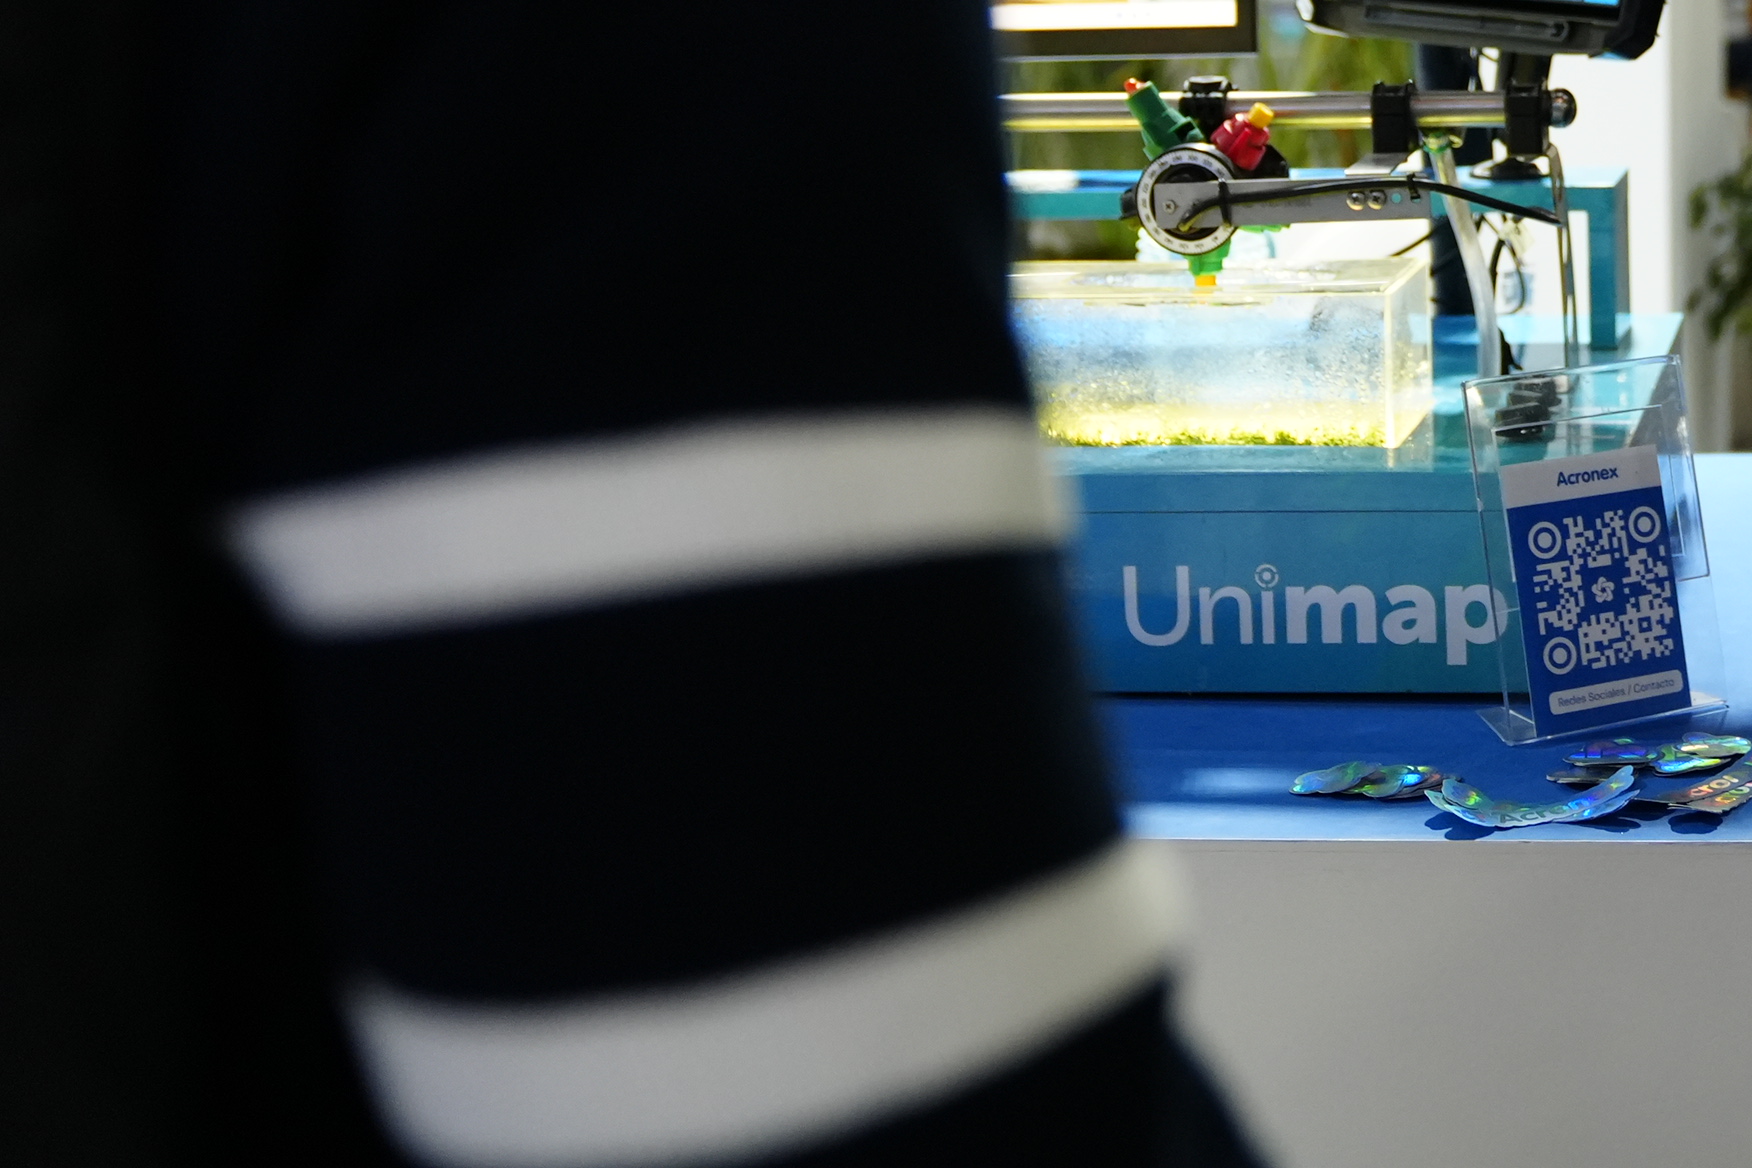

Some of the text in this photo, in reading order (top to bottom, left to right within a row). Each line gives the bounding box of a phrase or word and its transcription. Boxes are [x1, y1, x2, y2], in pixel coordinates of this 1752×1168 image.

[1556, 466, 1618, 487] Acronex
[1122, 563, 1508, 666] Unimap
[1557, 695, 1587, 708] Redes
[1588, 688, 1626, 703] Sociales
[1633, 678, 1675, 694] Contacto
